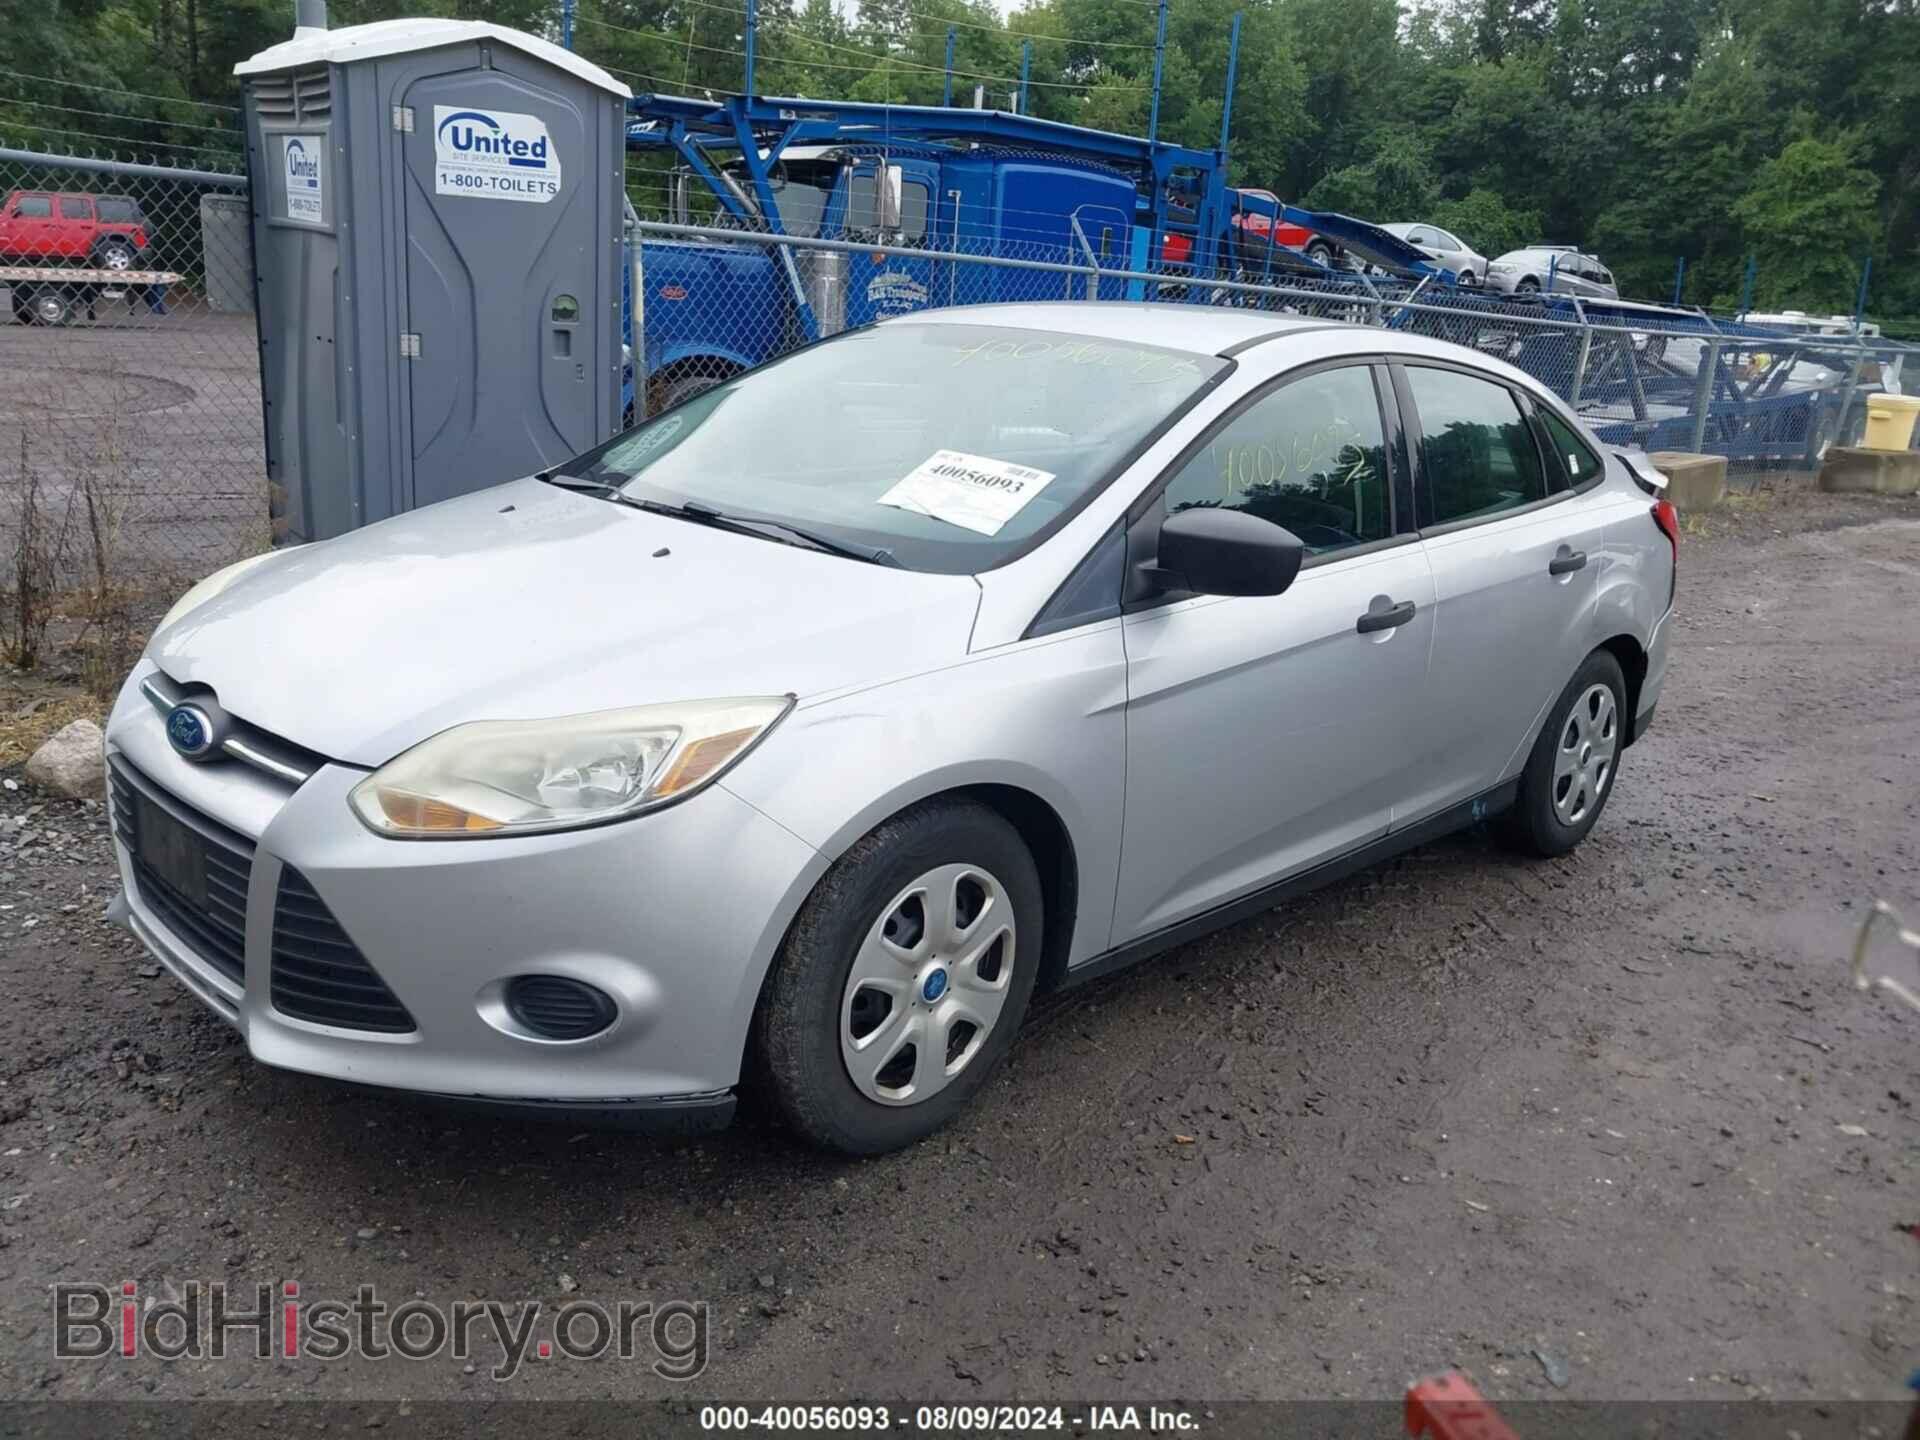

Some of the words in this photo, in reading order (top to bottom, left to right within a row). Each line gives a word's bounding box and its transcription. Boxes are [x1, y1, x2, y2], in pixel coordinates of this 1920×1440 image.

[451, 125, 547, 159] United
[289, 153, 318, 177] United
[440, 173, 558, 195] 1-800-TOILETS
[930, 464, 1025, 494] 40056093
